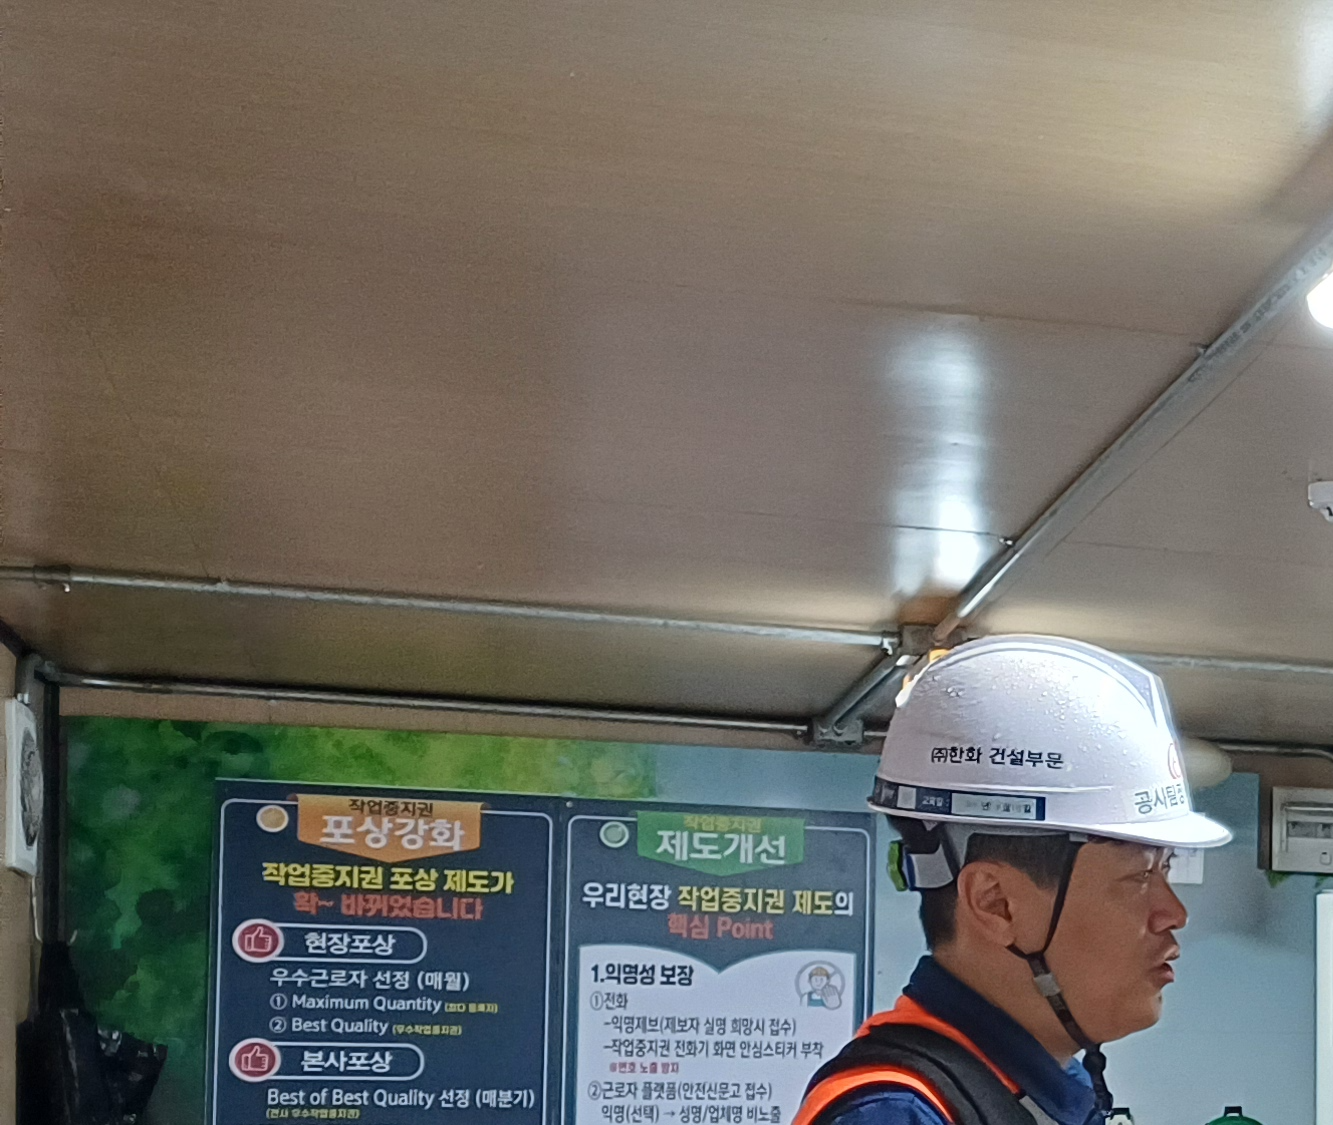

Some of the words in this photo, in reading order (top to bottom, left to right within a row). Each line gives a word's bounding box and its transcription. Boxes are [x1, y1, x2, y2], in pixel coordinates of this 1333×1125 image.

[989, 748, 1064, 769] 건설부문
[349, 798, 434, 817] 작업중지권
[320, 815, 465, 850] 포상강화
[684, 815, 764, 833] 작업중지권
[656, 830, 786, 865] 제도개선
[262, 862, 383, 890] 작업중지권
[389, 867, 439, 891] 포상
[443, 869, 514, 894] 제도가
[582, 882, 671, 911] 우리현장
[678, 886, 785, 914] 작업중지권
[792, 890, 854, 917] 제도의
[668, 914, 710, 939] 핵심
[717, 918, 774, 939] Point
[304, 932, 396, 956] 현장포상
[269, 969, 369, 988] 우수근로자
[372, 971, 410, 990] 선정
[417, 972, 470, 992] (매월)
[591, 964, 656, 985] 1.익명성
[659, 965, 695, 986] 보장
[292, 994, 369, 1010] Maximum
[373, 996, 442, 1015] Quantity
[292, 1017, 328, 1033] Best
[331, 1018, 388, 1036] Quality
[704, 1018, 727, 1036] 실명
[674, 1041, 709, 1058] 전화기
[713, 1041, 736, 1058] 화면
[739, 1040, 798, 1059] 안심스티커
[800, 1041, 824, 1059] 부착
[301, 1051, 392, 1074] 본사포상
[267, 1089, 305, 1105] Best
[309, 1089, 329, 1105] of
[332, 1089, 369, 1106] Best
[373, 1090, 435, 1110] Quality
[438, 1089, 470, 1109] 선정
[475, 1089, 535, 1109] (매분기)
[744, 1082, 772, 1101] 접수)
[601, 1105, 660, 1125] 익명(선택)
[679, 1105, 743, 1124] 성명/업체명
